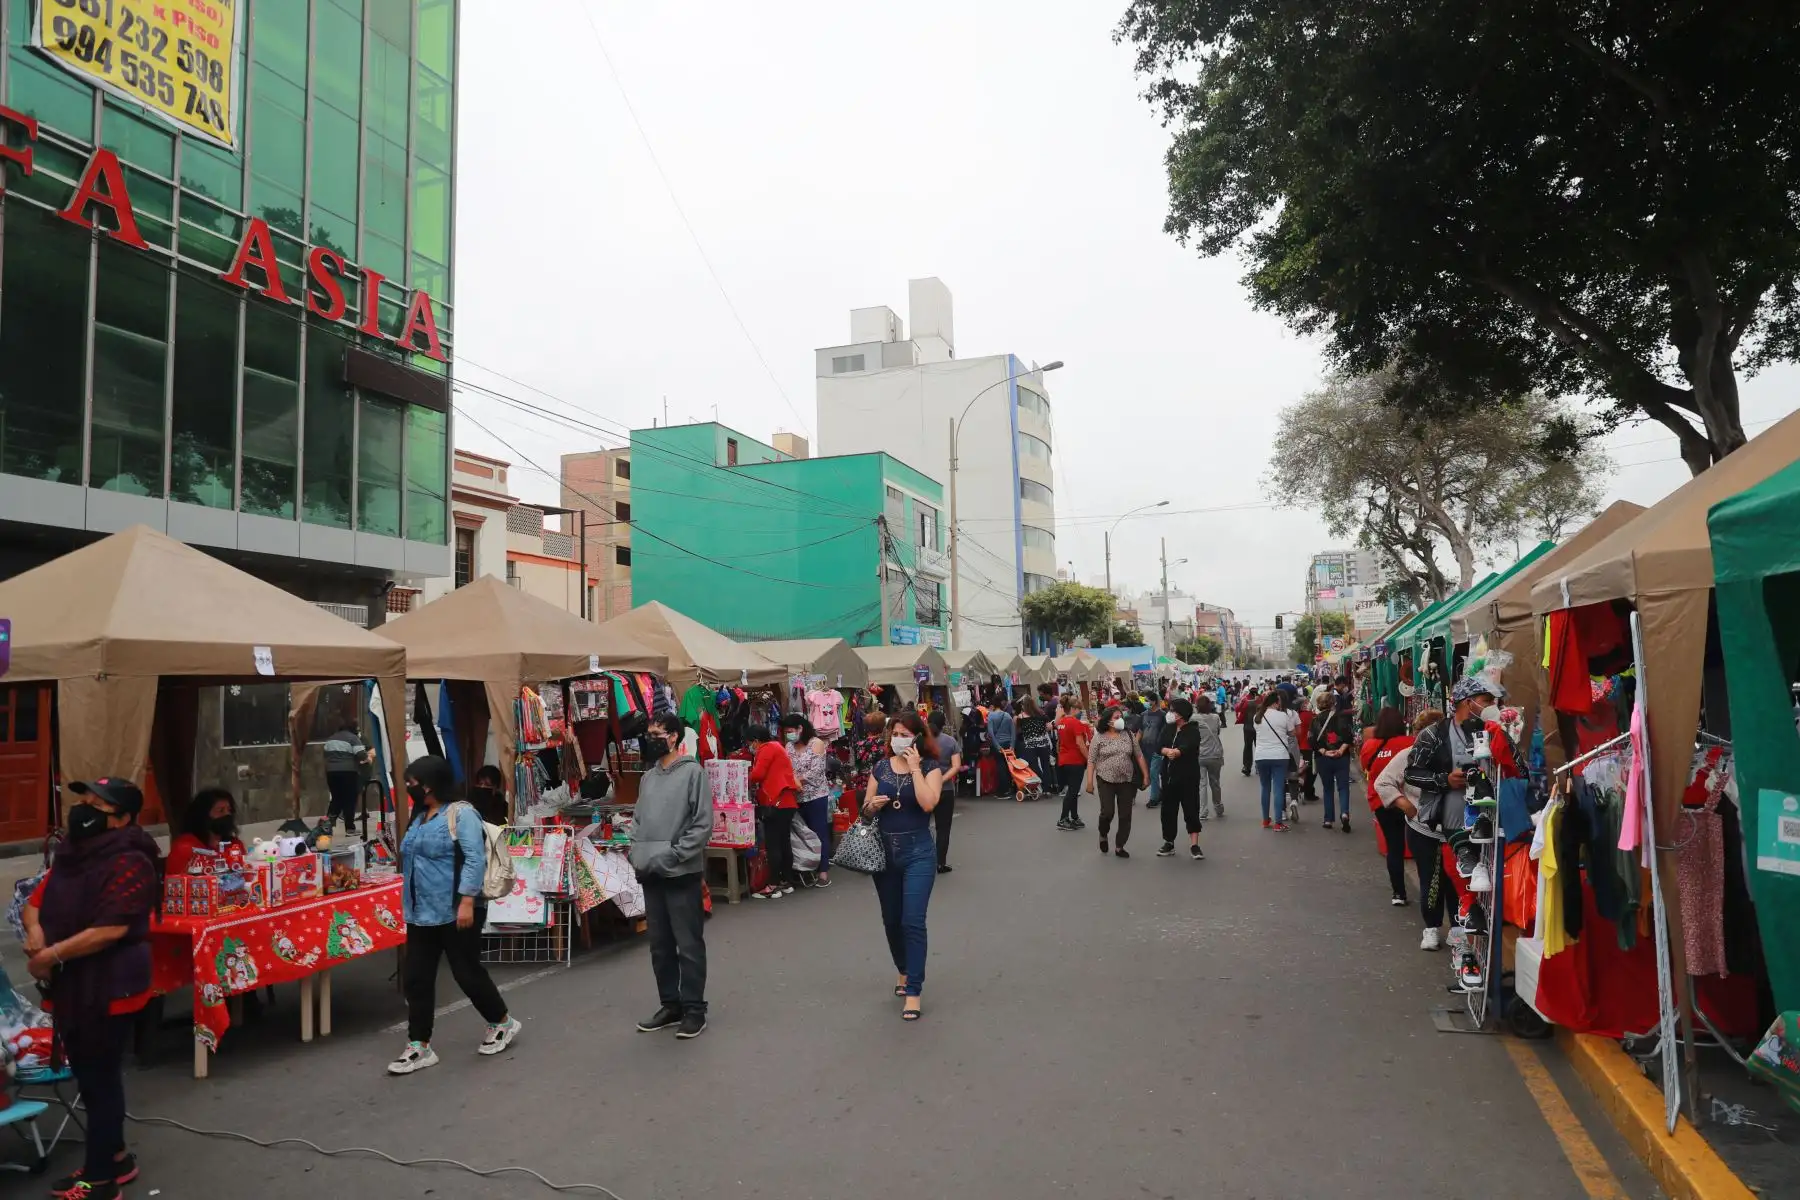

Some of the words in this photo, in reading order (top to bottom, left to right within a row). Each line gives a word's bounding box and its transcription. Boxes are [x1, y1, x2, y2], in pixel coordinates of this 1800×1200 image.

[53, 15, 113, 74] 994
[120, 48, 175, 107] 535
[182, 80, 225, 132] 748
[117, 5, 169, 63] 232
[177, 38, 224, 94] 598
[220, 216, 447, 363] ASIA
